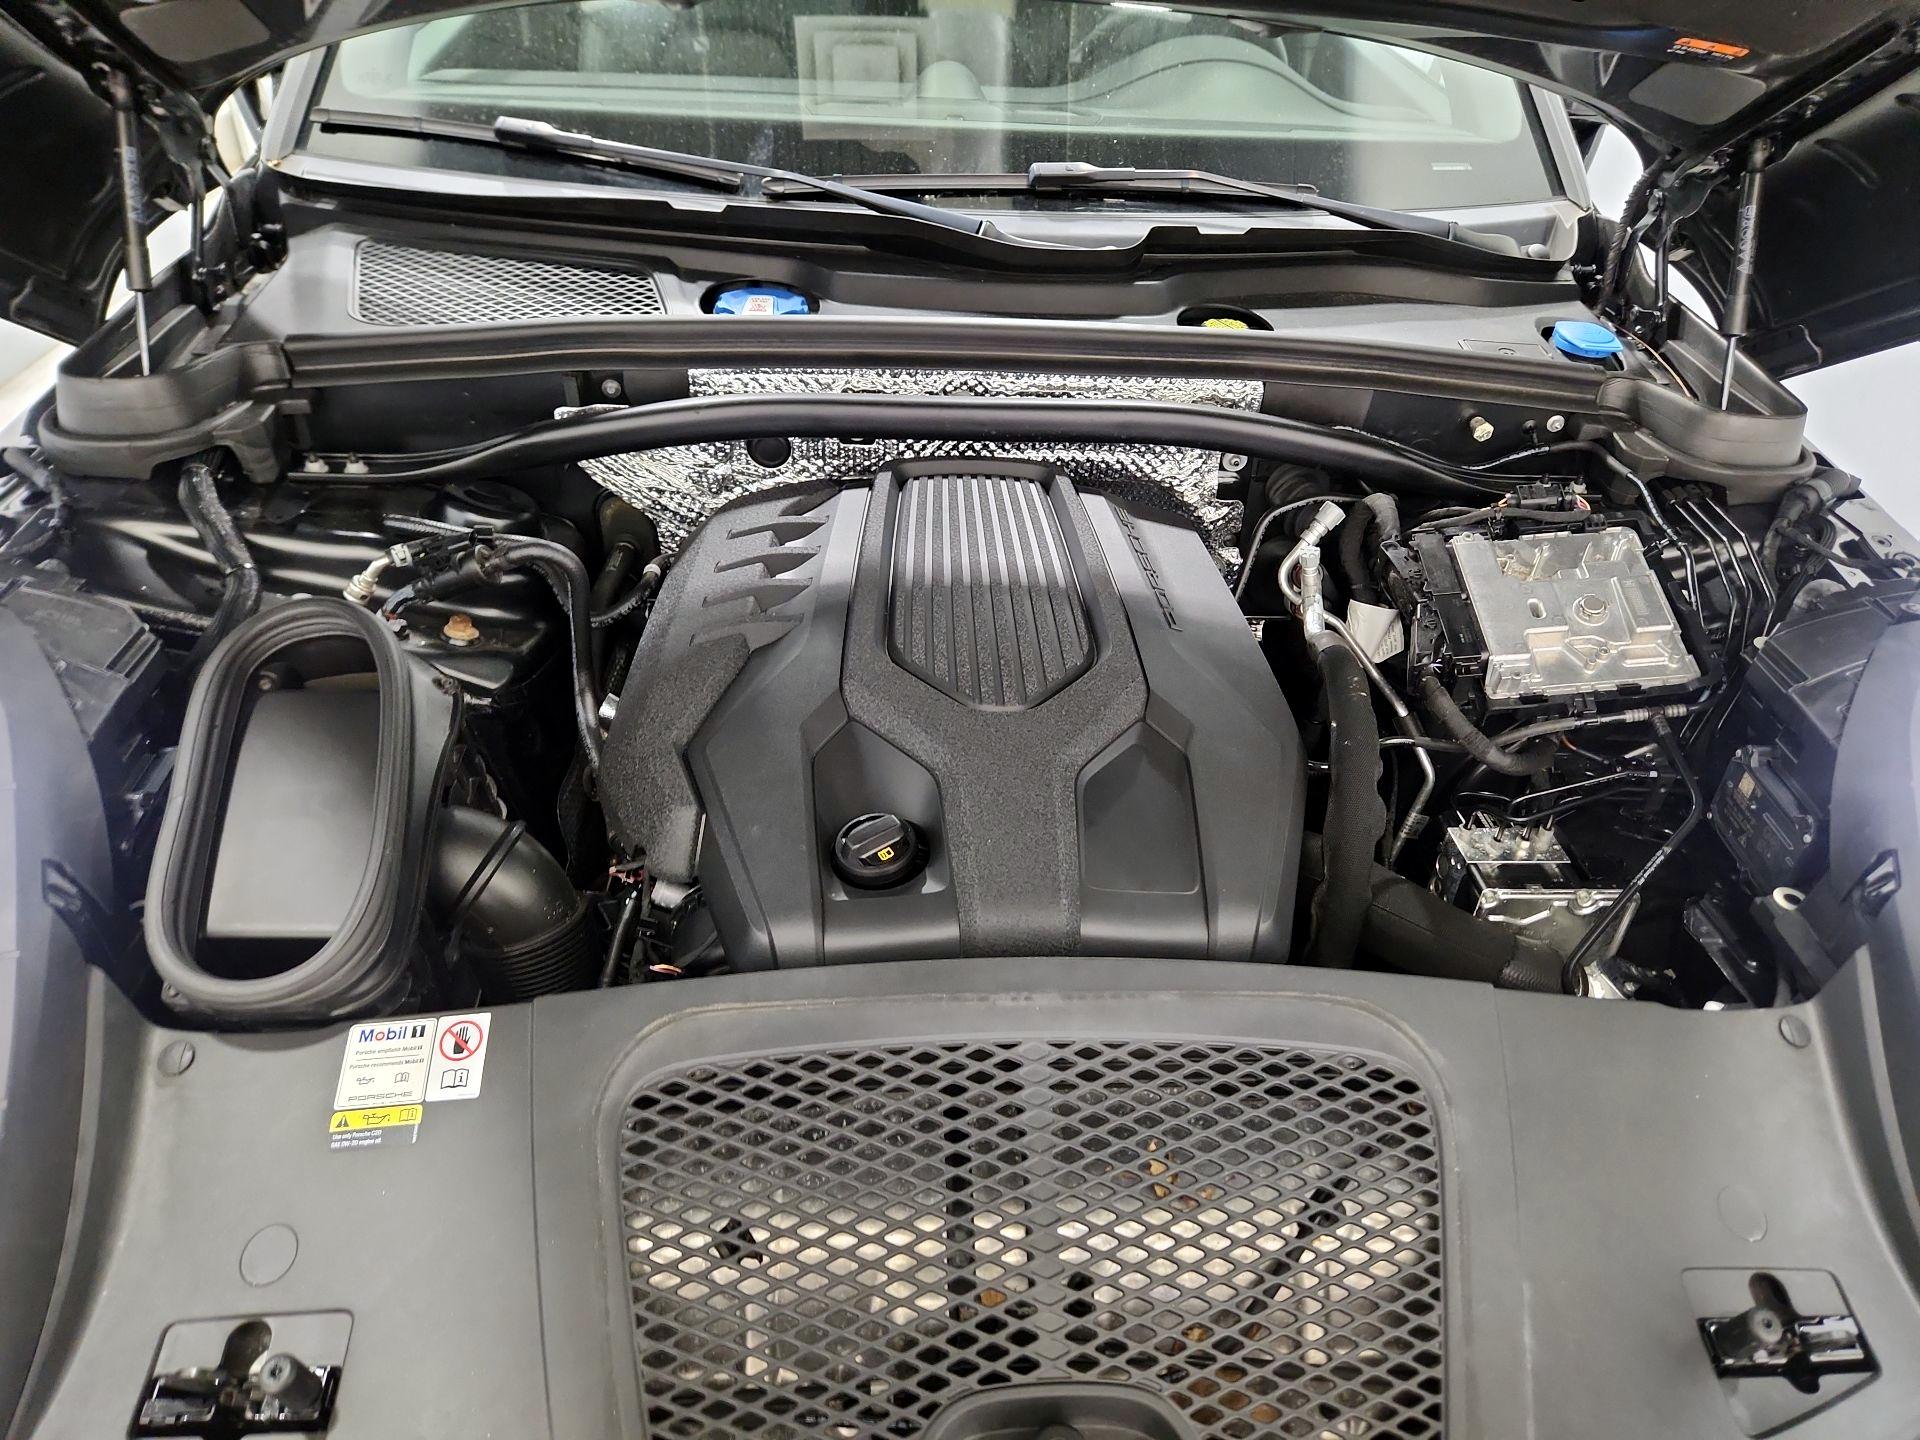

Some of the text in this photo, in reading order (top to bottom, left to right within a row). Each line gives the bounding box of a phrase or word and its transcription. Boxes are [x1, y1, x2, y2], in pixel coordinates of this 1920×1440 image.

[358, 1024, 426, 1043] Mobil 1
[347, 1091, 413, 1102] PORSCHE
